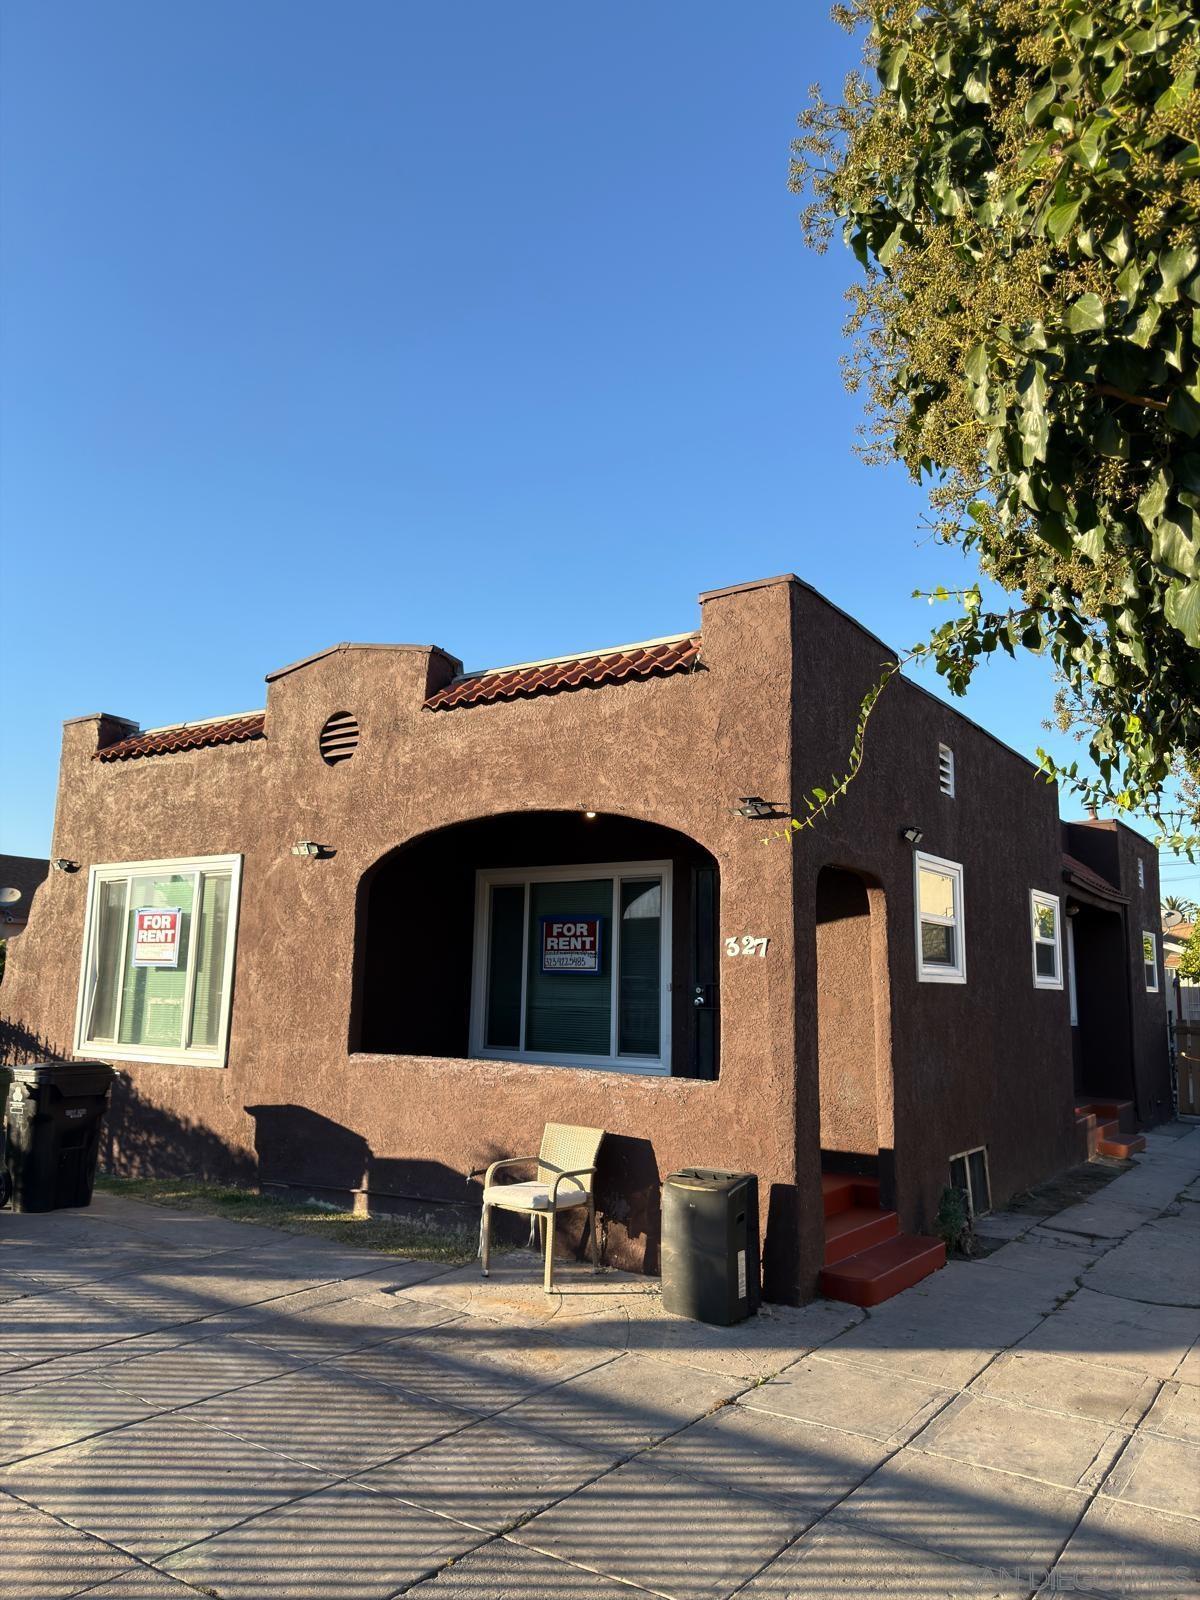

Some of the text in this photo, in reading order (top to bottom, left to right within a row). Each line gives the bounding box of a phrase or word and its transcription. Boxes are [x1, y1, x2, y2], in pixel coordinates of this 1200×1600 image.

[143, 915, 172, 929] FOR
[138, 930, 176, 942] RENT
[552, 923, 588, 936] FOR
[546, 937, 594, 950] RENT
[725, 935, 768, 957] 327
